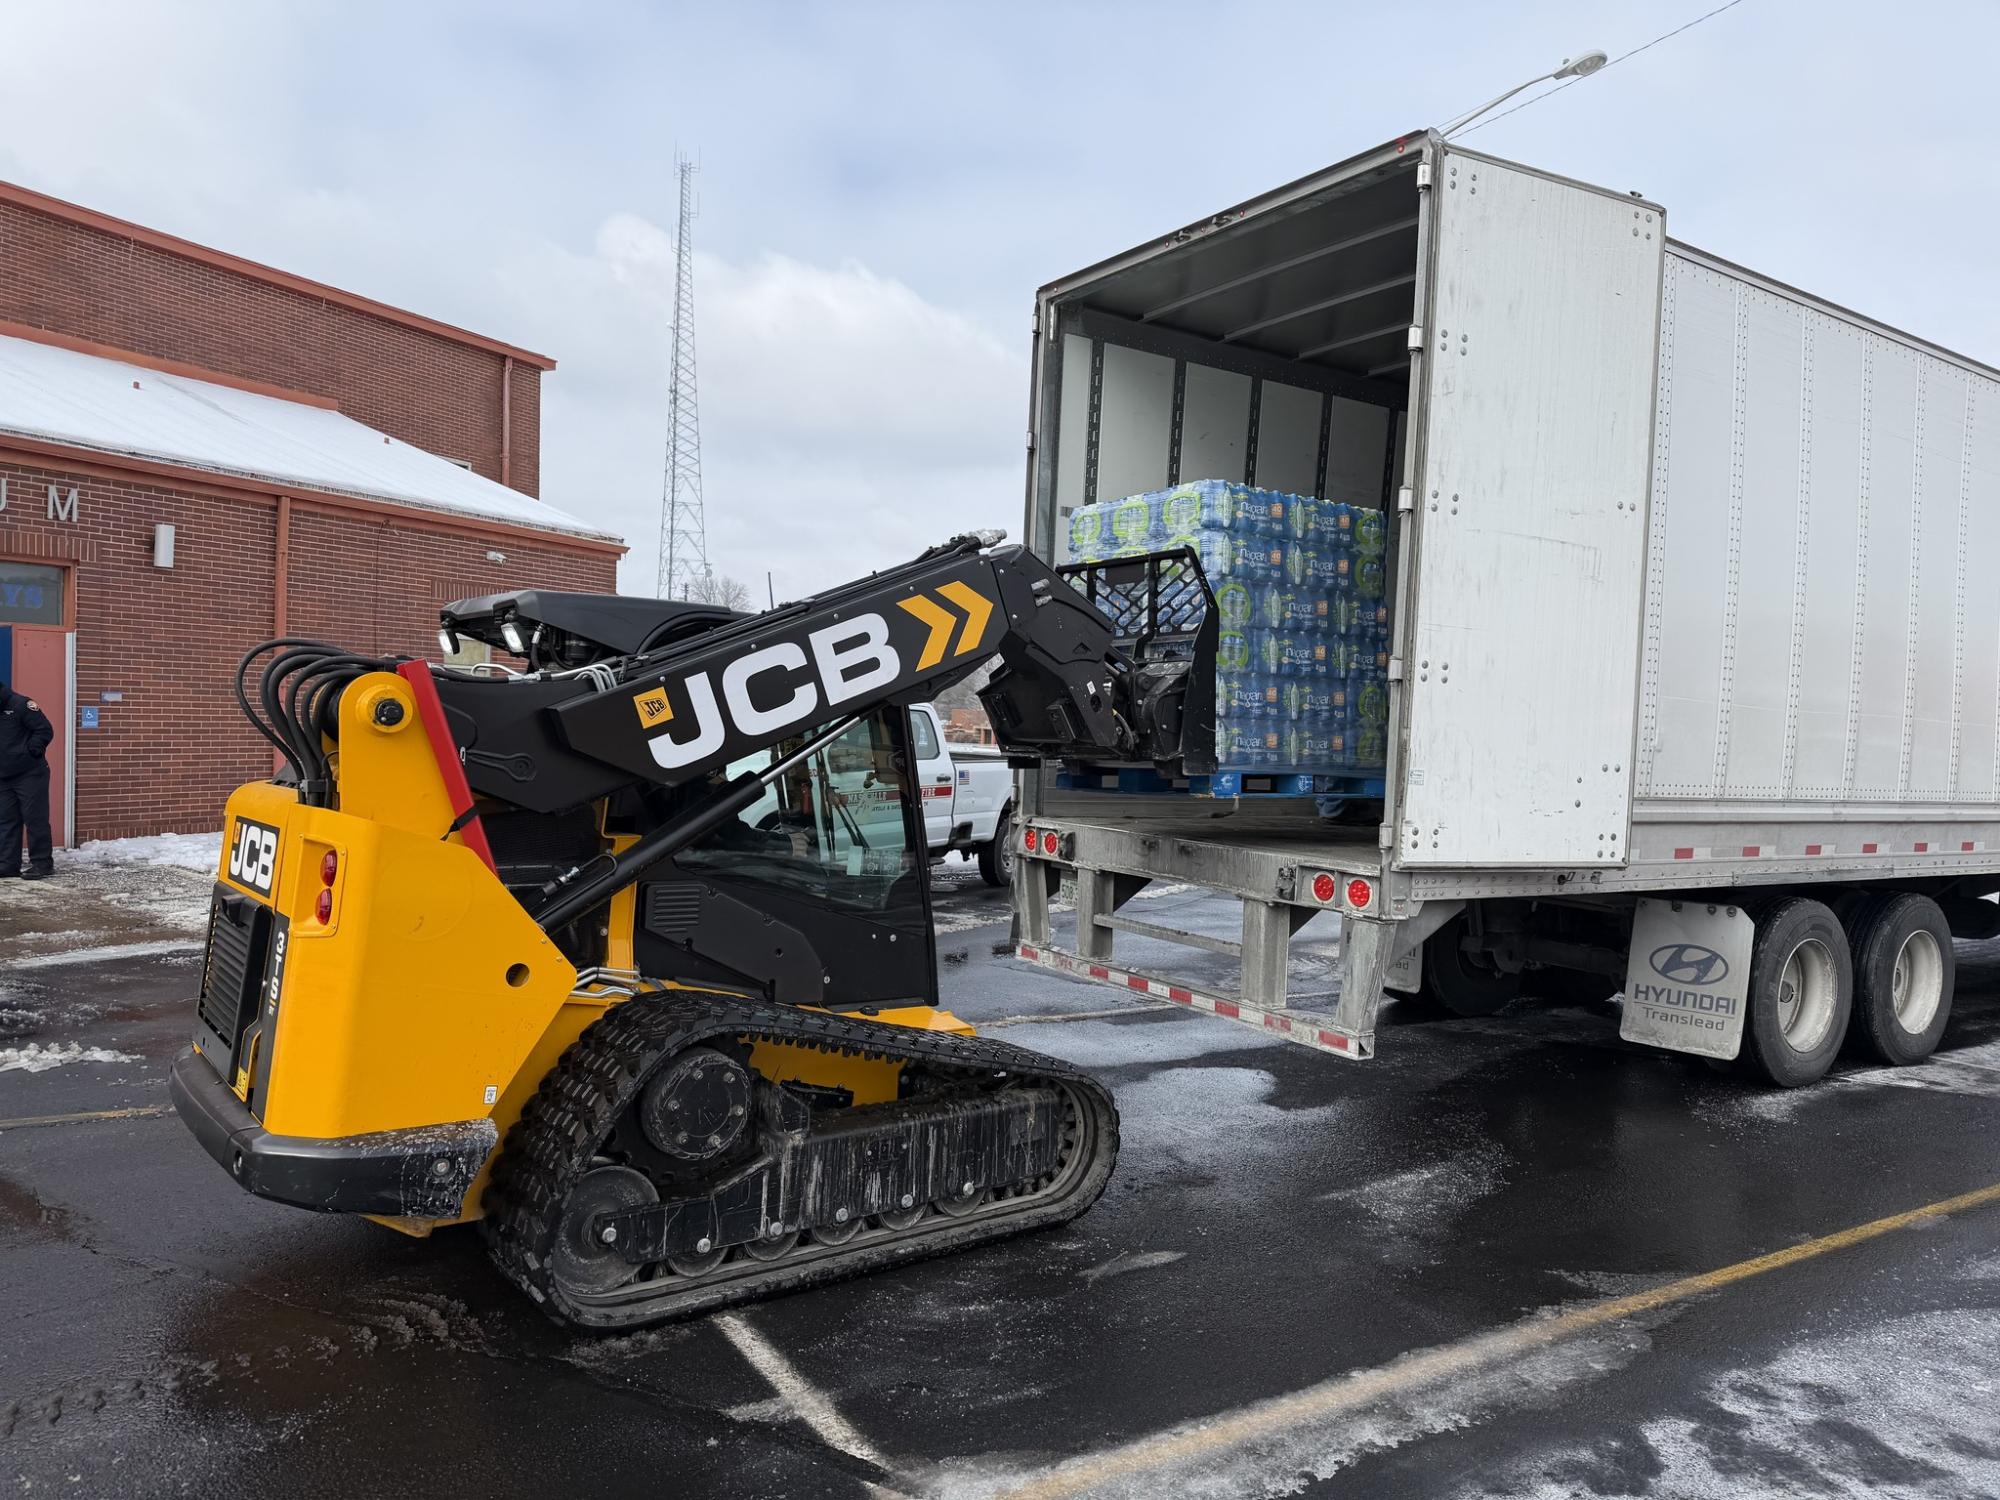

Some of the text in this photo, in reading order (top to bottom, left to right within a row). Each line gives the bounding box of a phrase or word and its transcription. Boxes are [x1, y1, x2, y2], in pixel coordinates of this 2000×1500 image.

[648, 612, 900, 769] JCB
[644, 699, 665, 717] JCB
[230, 823, 277, 890] JCB
[1634, 983, 1737, 1015] HYUNDAI
[1642, 1006, 1725, 1031] Translead
